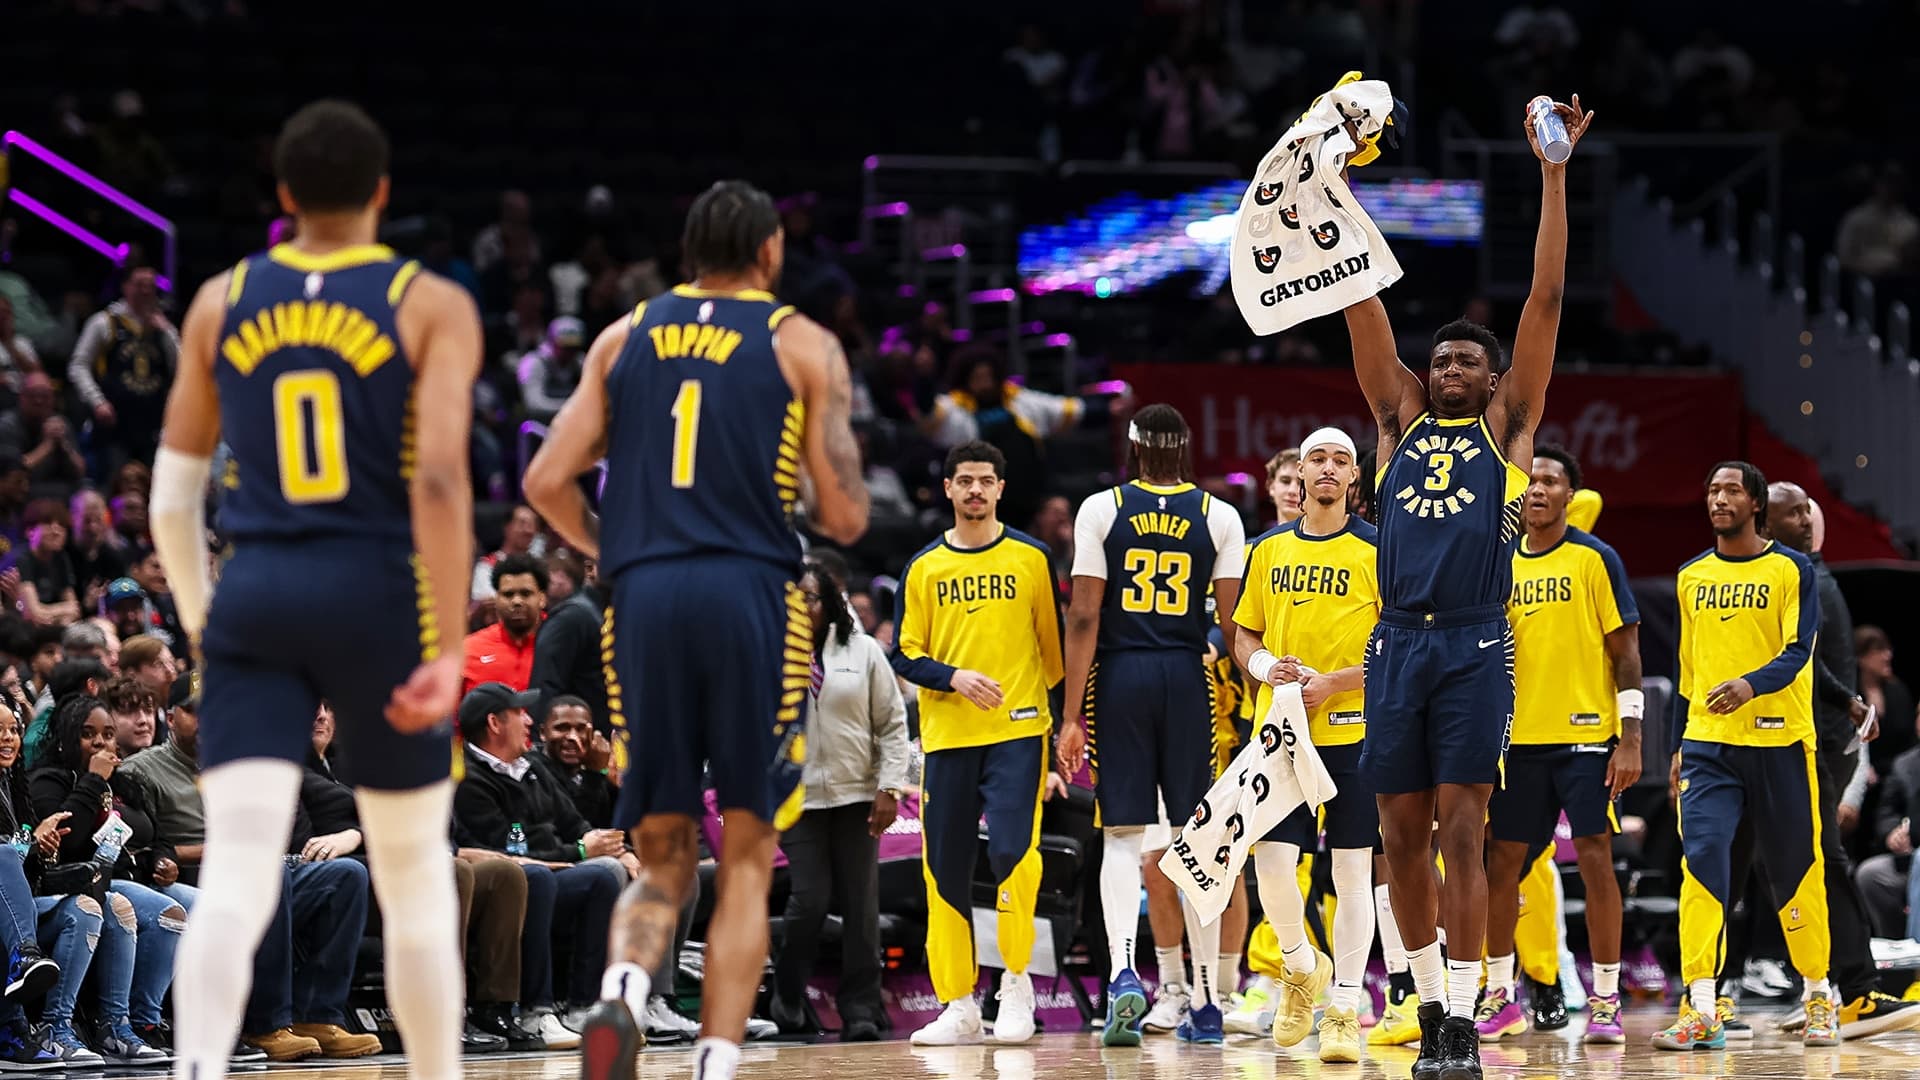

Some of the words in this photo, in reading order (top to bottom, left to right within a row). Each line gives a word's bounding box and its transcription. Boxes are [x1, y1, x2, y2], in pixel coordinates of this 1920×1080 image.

[648, 323, 743, 365] TOPPIN
[273, 368, 350, 505] 0
[671, 379, 702, 488] 1
[1424, 453, 1454, 491] 3
[1395, 485, 1476, 518] PACERS
[1129, 512, 1191, 540] TURNER
[937, 574, 1016, 607] PACERS
[1122, 548, 1192, 616] 33
[1271, 565, 1350, 597] PACERS
[1512, 576, 1572, 608] ACERS
[1695, 583, 1770, 610] PACERS
